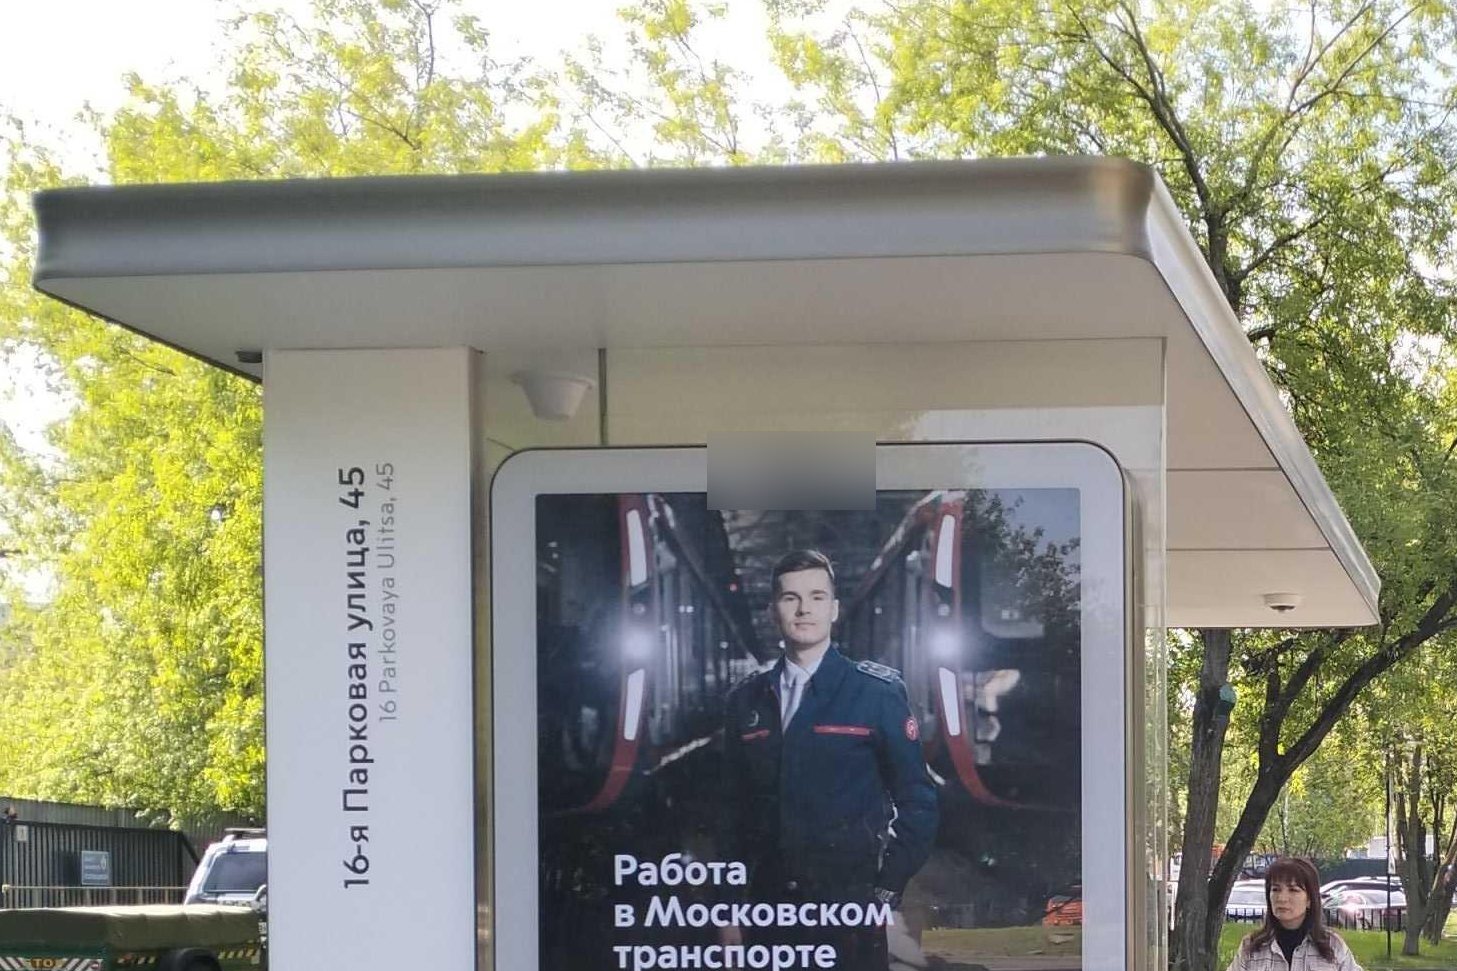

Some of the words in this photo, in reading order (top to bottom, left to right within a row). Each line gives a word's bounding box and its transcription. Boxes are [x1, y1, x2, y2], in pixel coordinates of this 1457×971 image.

[339, 466, 365, 509] 45
[376, 461, 394, 490] 45
[376, 497, 397, 569] Ulitsa,
[345, 518, 373, 631] улица,
[377, 577, 400, 694] Parkovaya
[343, 642, 374, 812] Парковая
[379, 699, 397, 723] 16
[344, 825, 370, 889] 16-я
[614, 853, 747, 886] Работа
[614, 905, 634, 926] в
[645, 896, 894, 927] Московском
